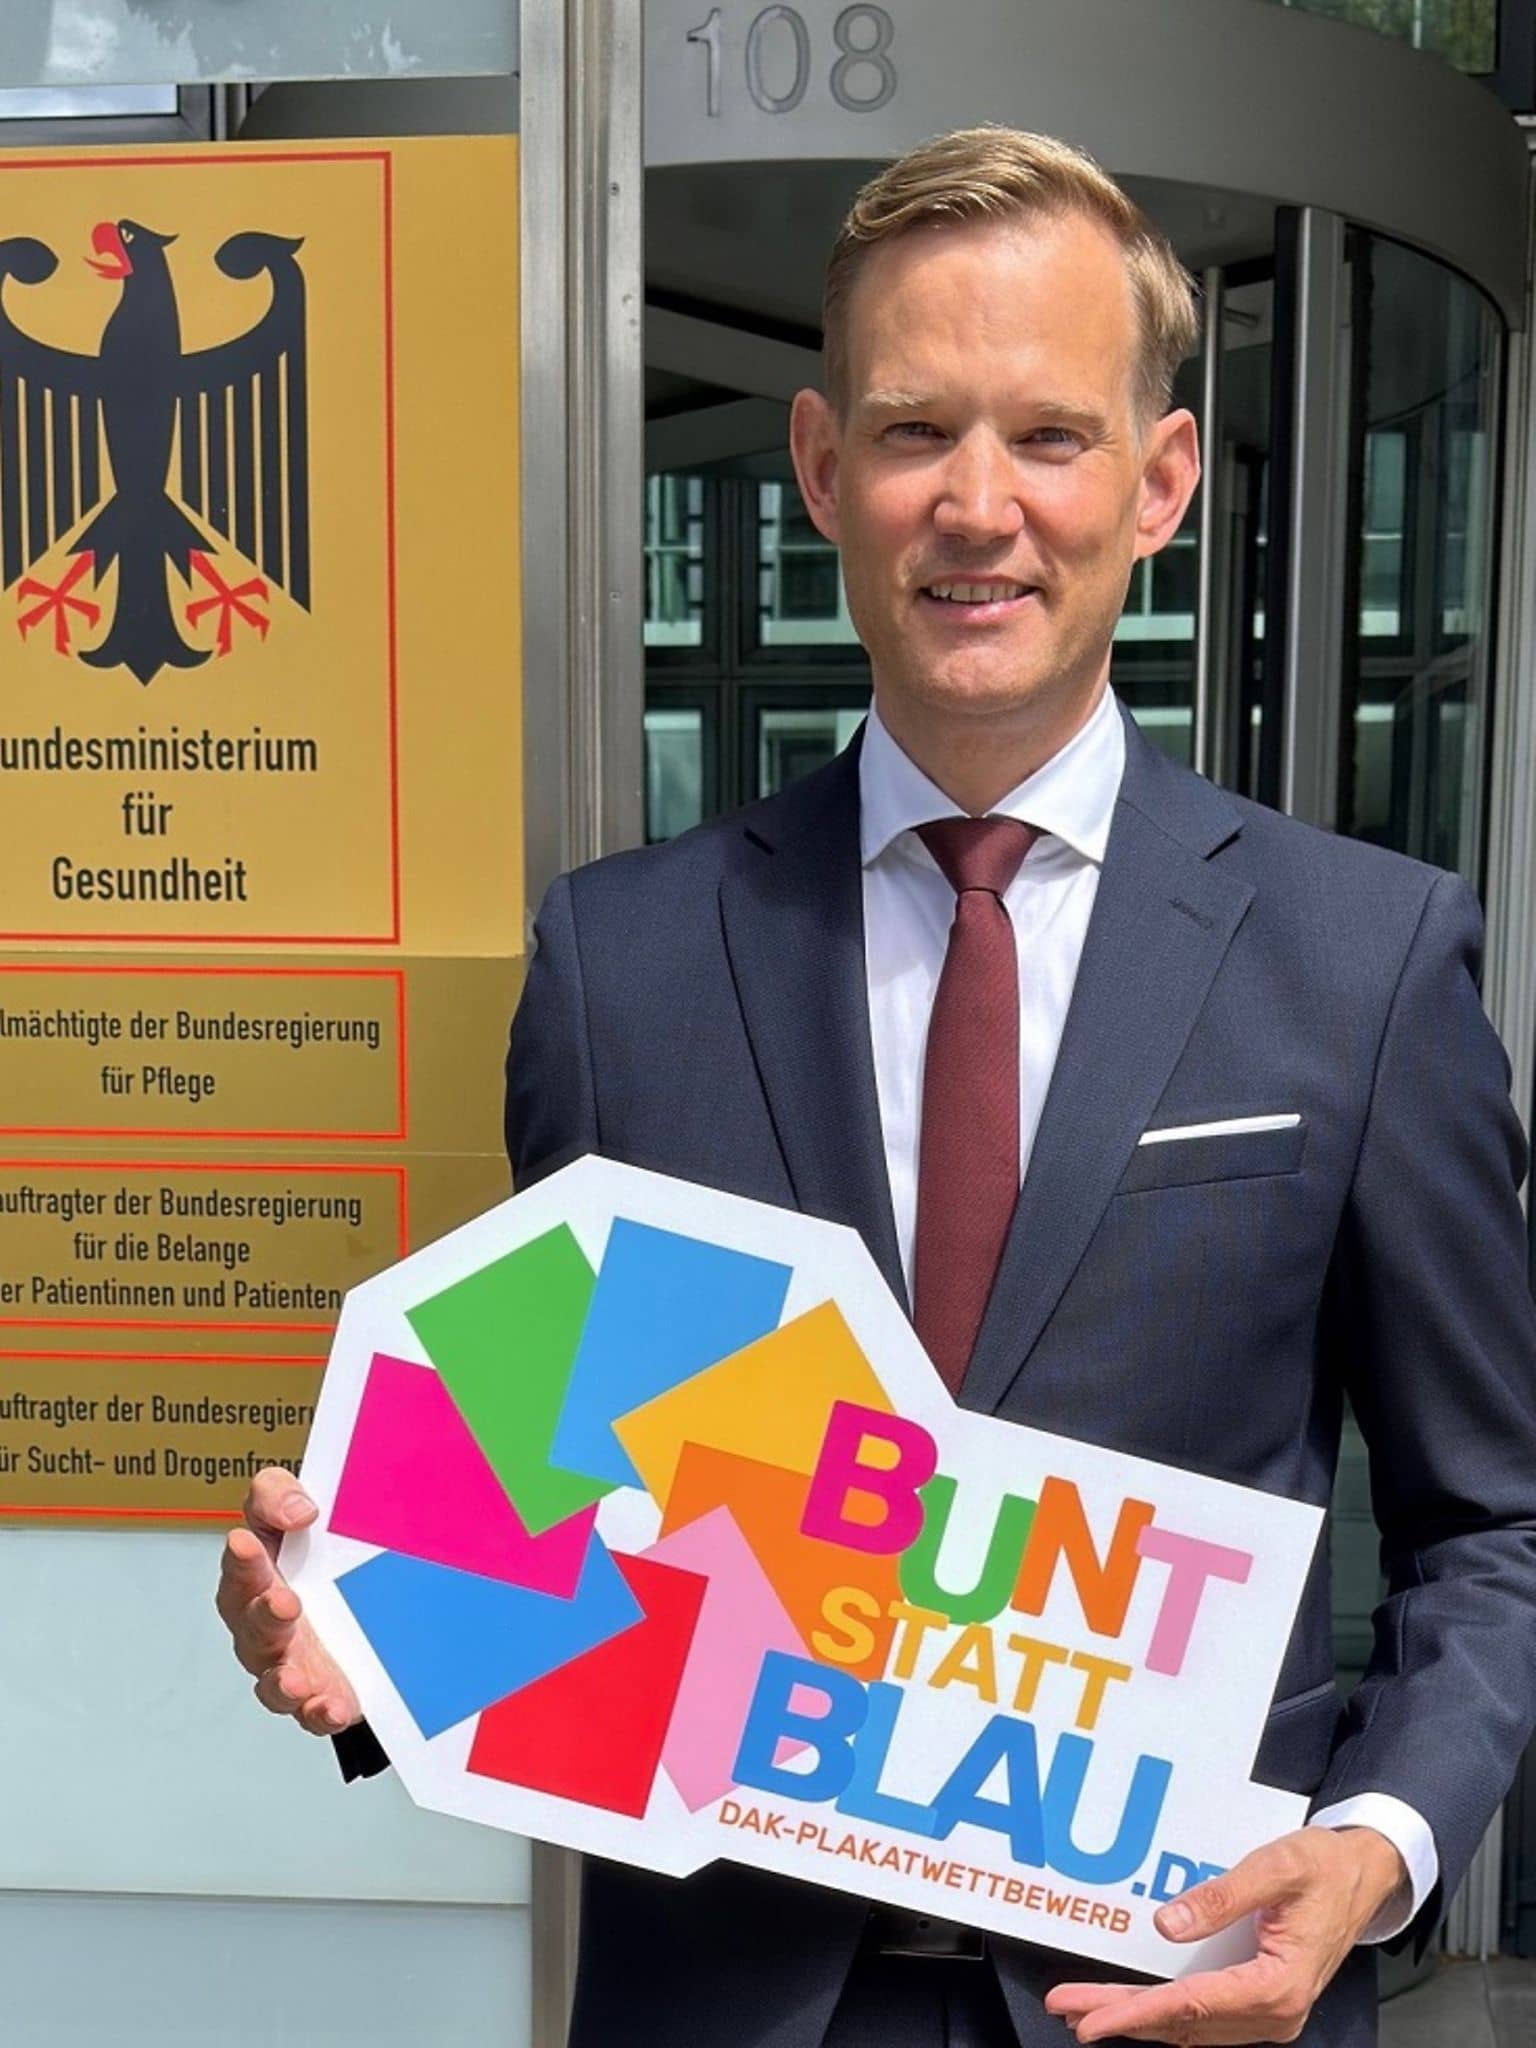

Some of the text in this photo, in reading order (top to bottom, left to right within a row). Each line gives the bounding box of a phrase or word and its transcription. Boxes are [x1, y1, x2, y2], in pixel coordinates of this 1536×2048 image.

[686, 3, 897, 118] 108
[121, 791, 173, 836] für
[52, 856, 248, 902] Gesundheit
[130, 1010, 169, 1040] der
[176, 1010, 381, 1051] Bundesregierung
[100, 1065, 216, 1104] für Pflege
[113, 1186, 153, 1216] der
[159, 1187, 362, 1227] Bundesregierung
[73, 1231, 251, 1271] für die Belange
[31, 1276, 175, 1308] Patientinnen
[183, 1280, 226, 1309] und
[234, 1281, 341, 1311] Patienten
[106, 1394, 145, 1423] der
[27, 1445, 105, 1475] Sucht-
[114, 1447, 156, 1476] und
[800, 1399, 1254, 1678] BUNT
[810, 1583, 1132, 1732] STATT
[718, 1799, 1132, 1935] DAK-PLAKATWETTBEWERB
